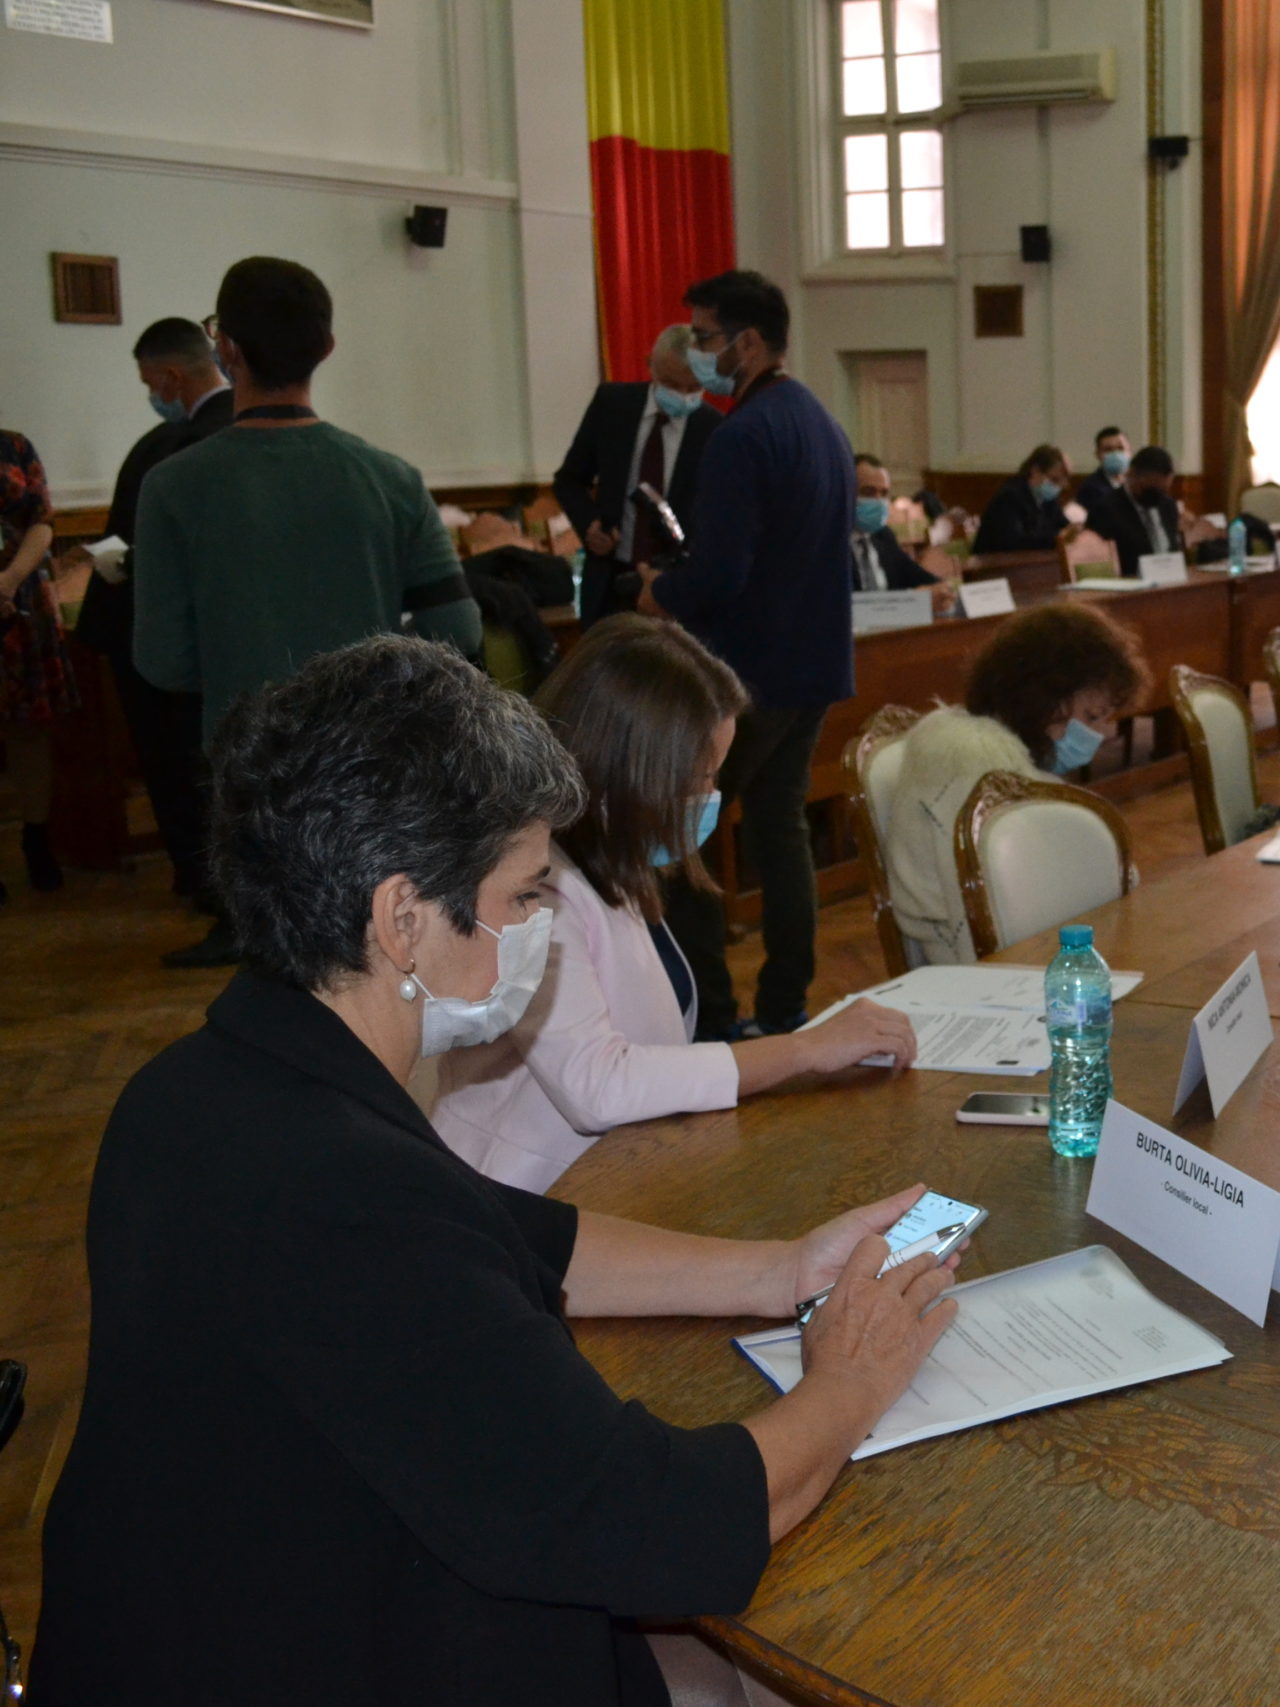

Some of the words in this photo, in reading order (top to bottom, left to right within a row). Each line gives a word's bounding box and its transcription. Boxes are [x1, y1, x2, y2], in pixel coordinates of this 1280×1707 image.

[1136, 1132, 1172, 1165] BURTA
[1175, 1155, 1244, 1208] OLIVIA-LIGIA
[1163, 1180, 1191, 1204] Consilier
[1192, 1198, 1208, 1215] local
